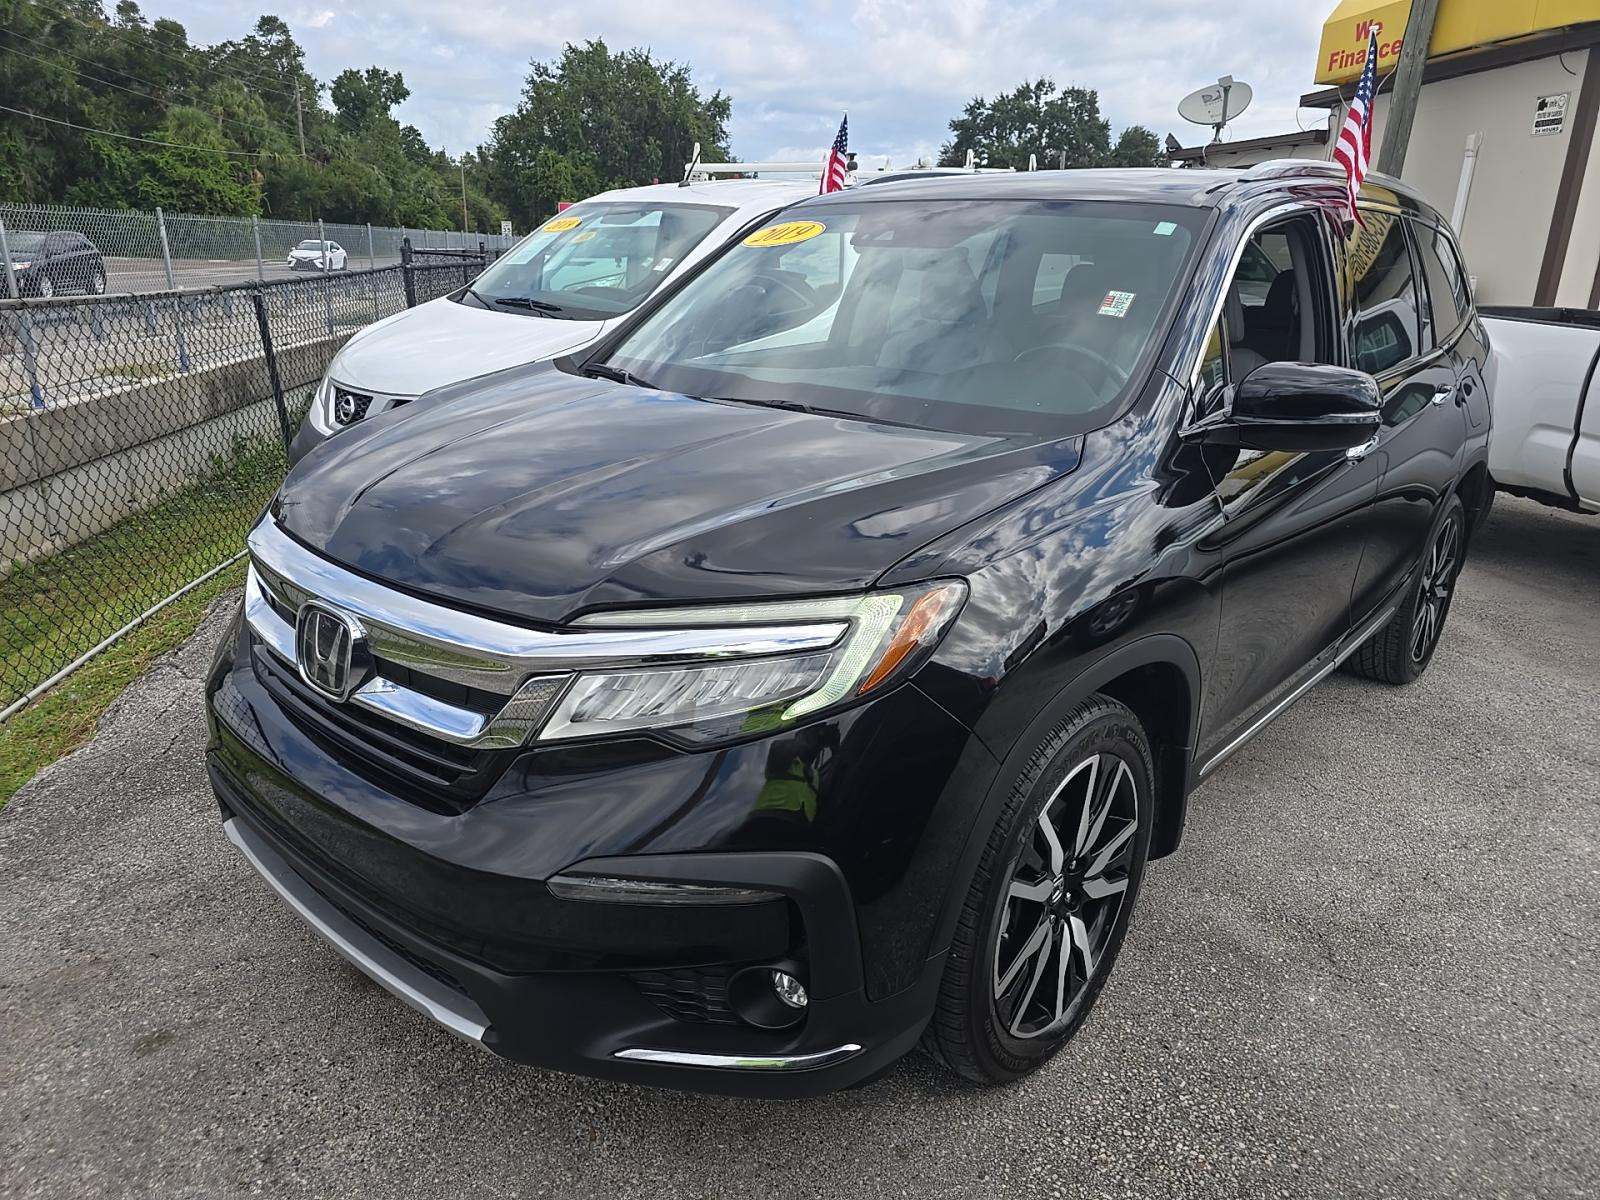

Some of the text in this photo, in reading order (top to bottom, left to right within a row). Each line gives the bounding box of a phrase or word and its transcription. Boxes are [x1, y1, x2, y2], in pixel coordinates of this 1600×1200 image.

[1355, 19, 1384, 41] We
[1328, 39, 1403, 72] Finace
[750, 224, 816, 243] 2019
